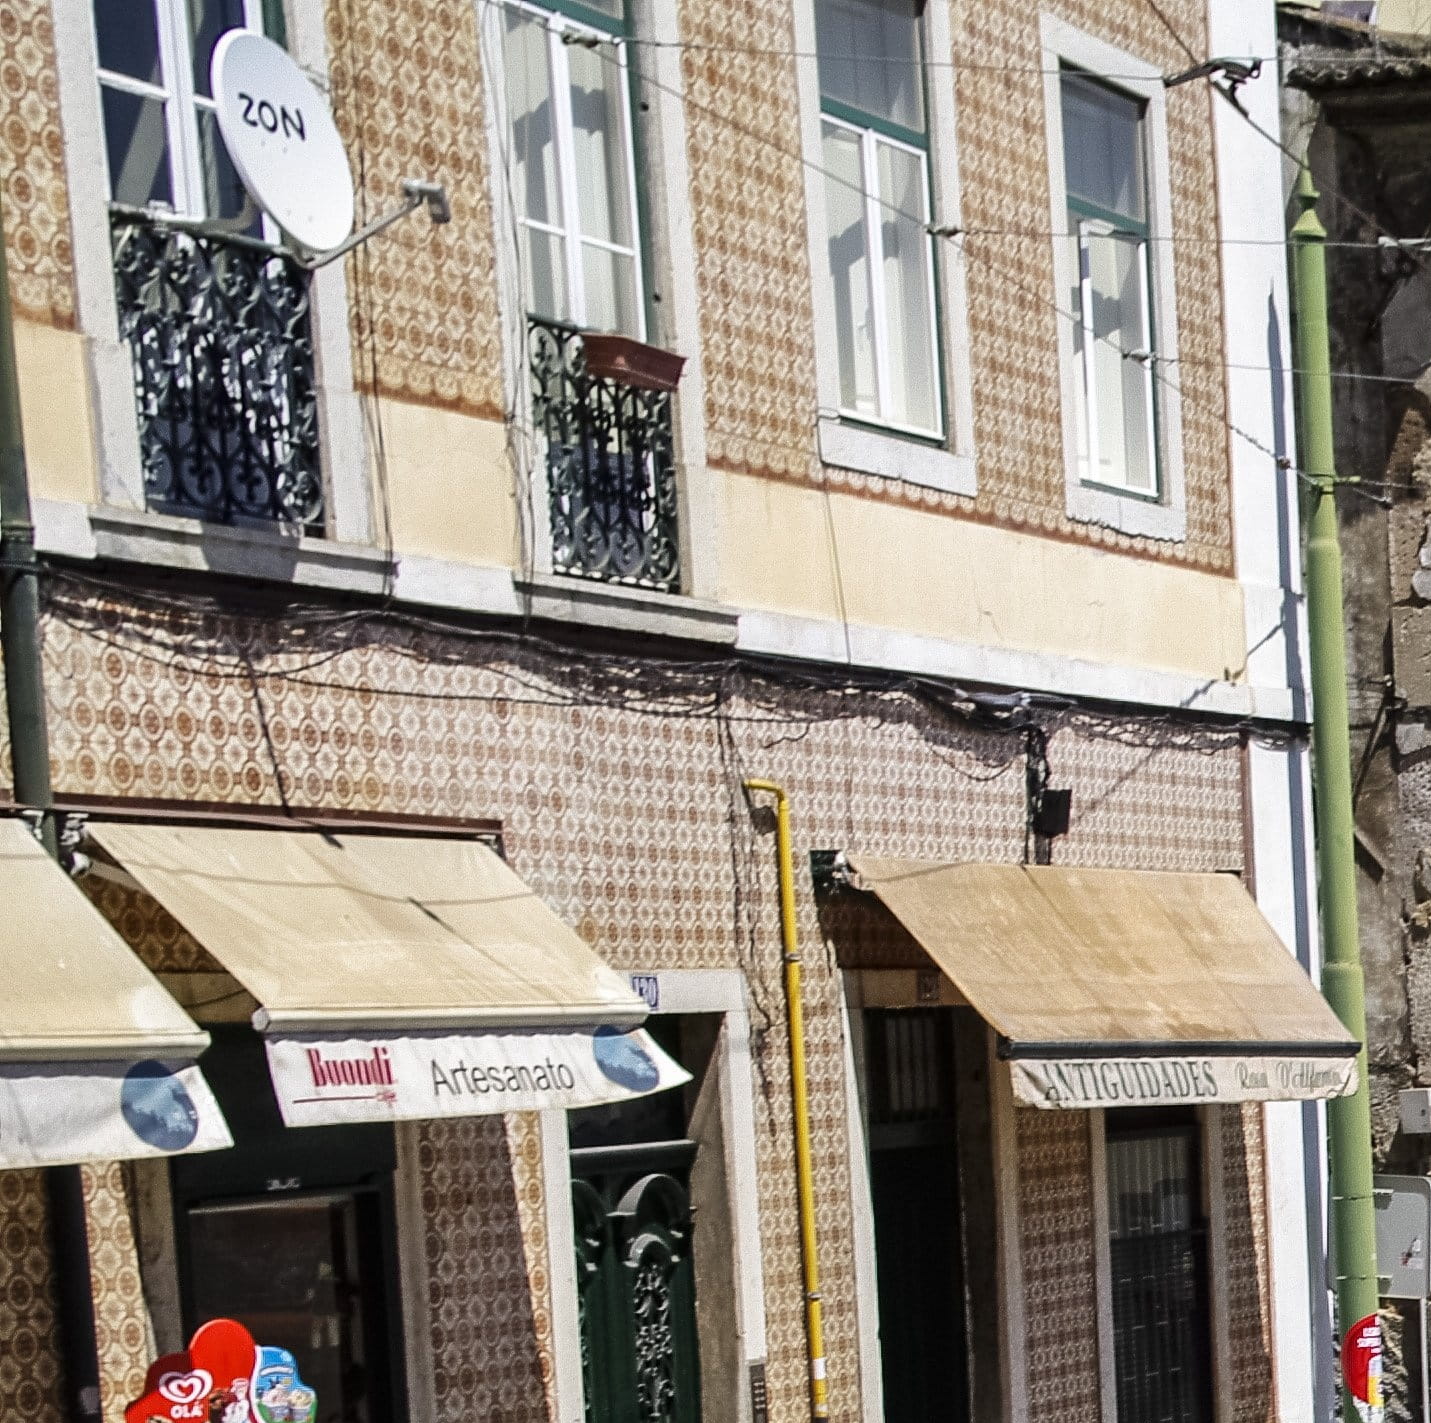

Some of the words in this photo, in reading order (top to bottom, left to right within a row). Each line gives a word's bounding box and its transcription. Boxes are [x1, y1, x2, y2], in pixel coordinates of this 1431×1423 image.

[238, 92, 305, 142] ZON
[306, 1047, 393, 1087] Buondi
[431, 1058, 575, 1097] Artesanato
[1044, 1061, 1219, 1100] ANTIGUIDADES
[170, 1400, 204, 1419] OLÁ
